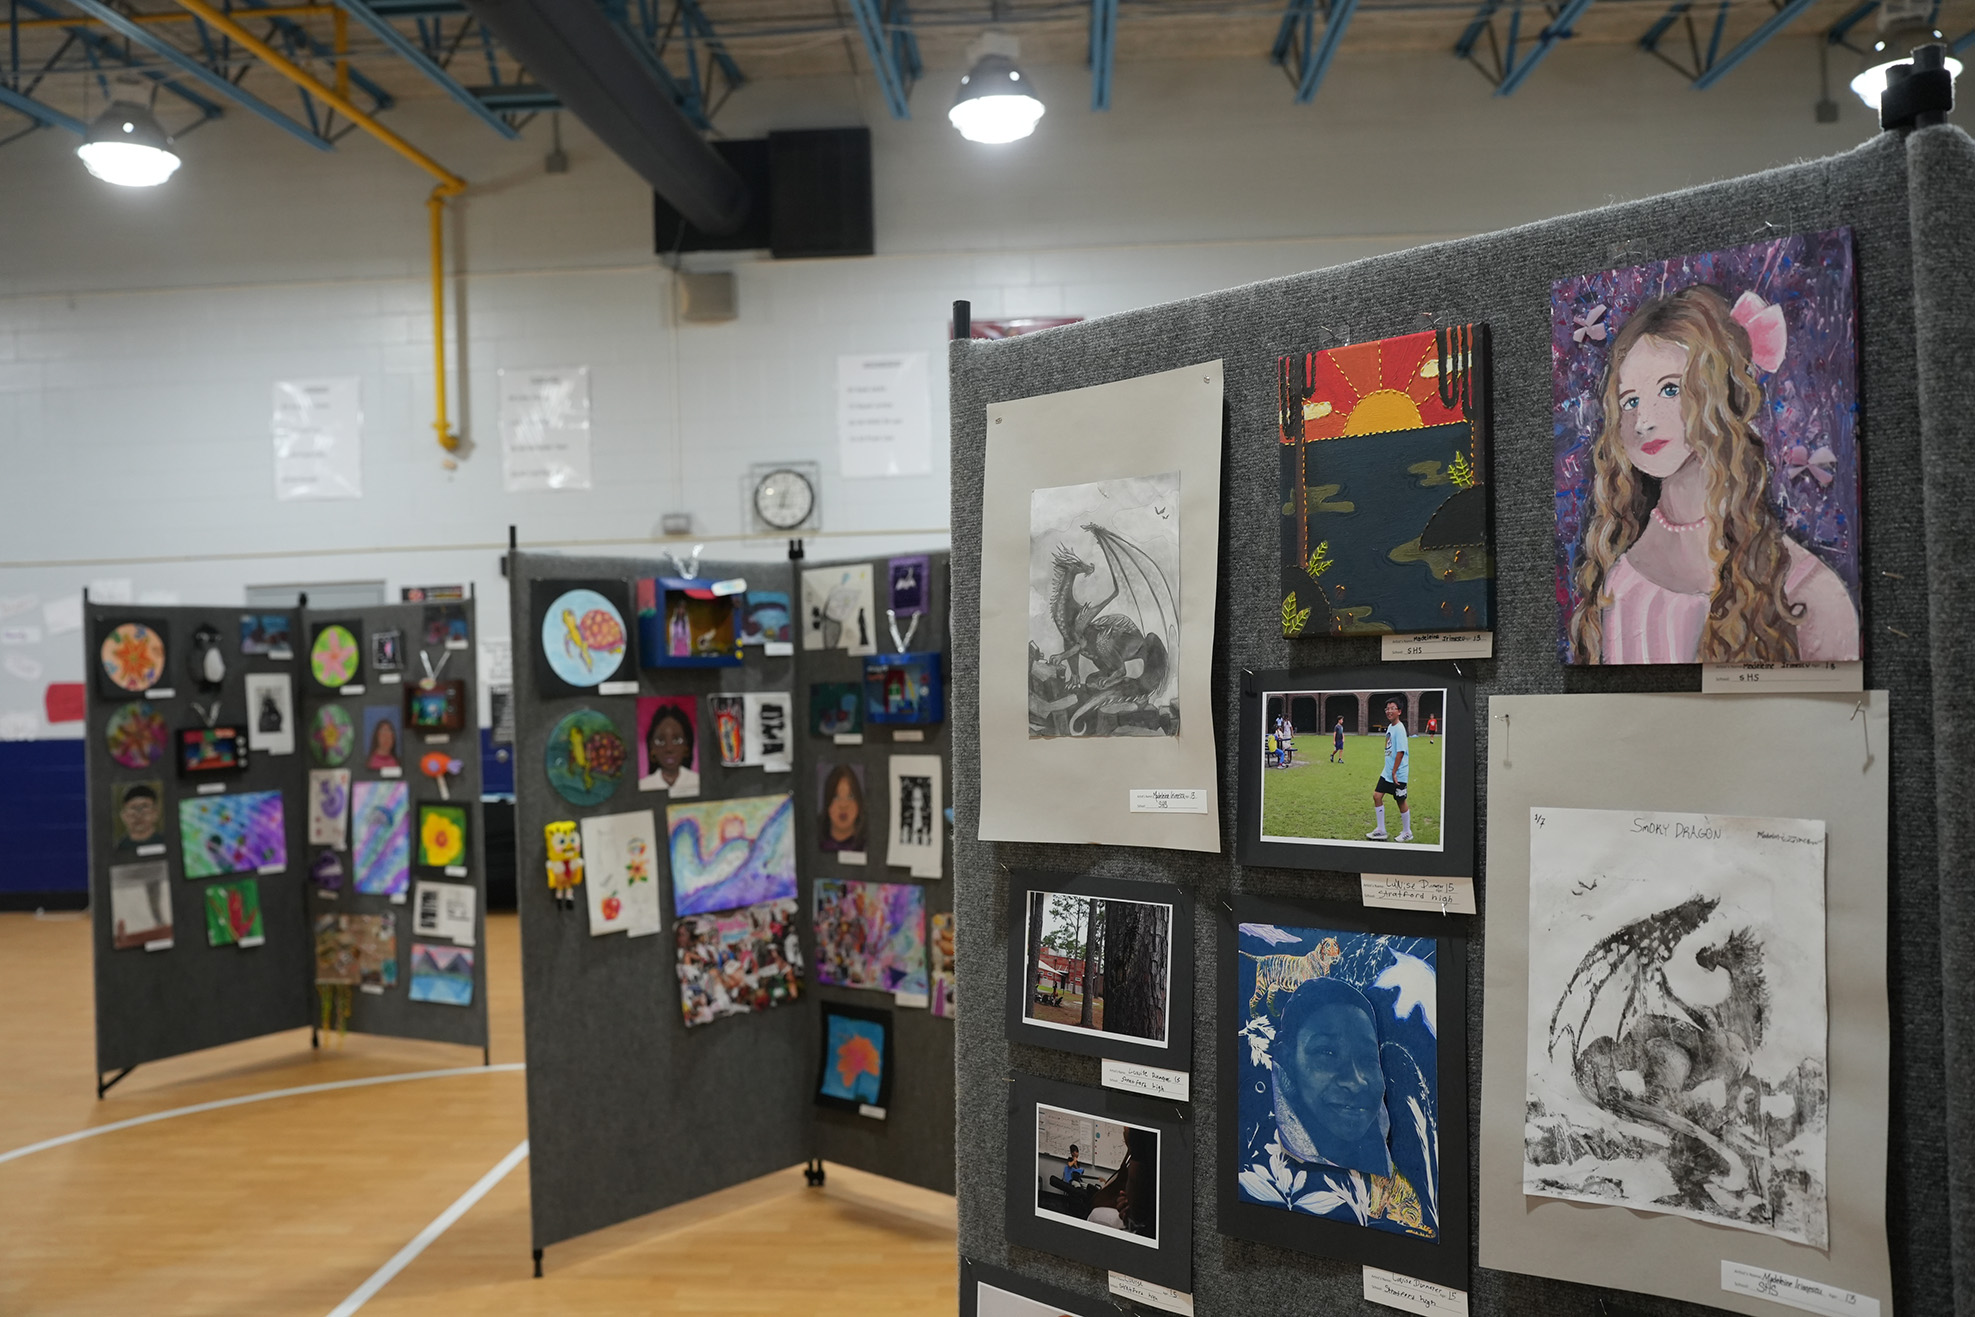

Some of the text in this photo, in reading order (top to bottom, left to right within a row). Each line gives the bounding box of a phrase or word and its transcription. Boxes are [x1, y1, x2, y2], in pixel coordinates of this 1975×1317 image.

[1407, 647, 1422, 655] SHS
[1675, 822, 1722, 840] DRAGON
[1448, 1290, 1457, 1300] 15
